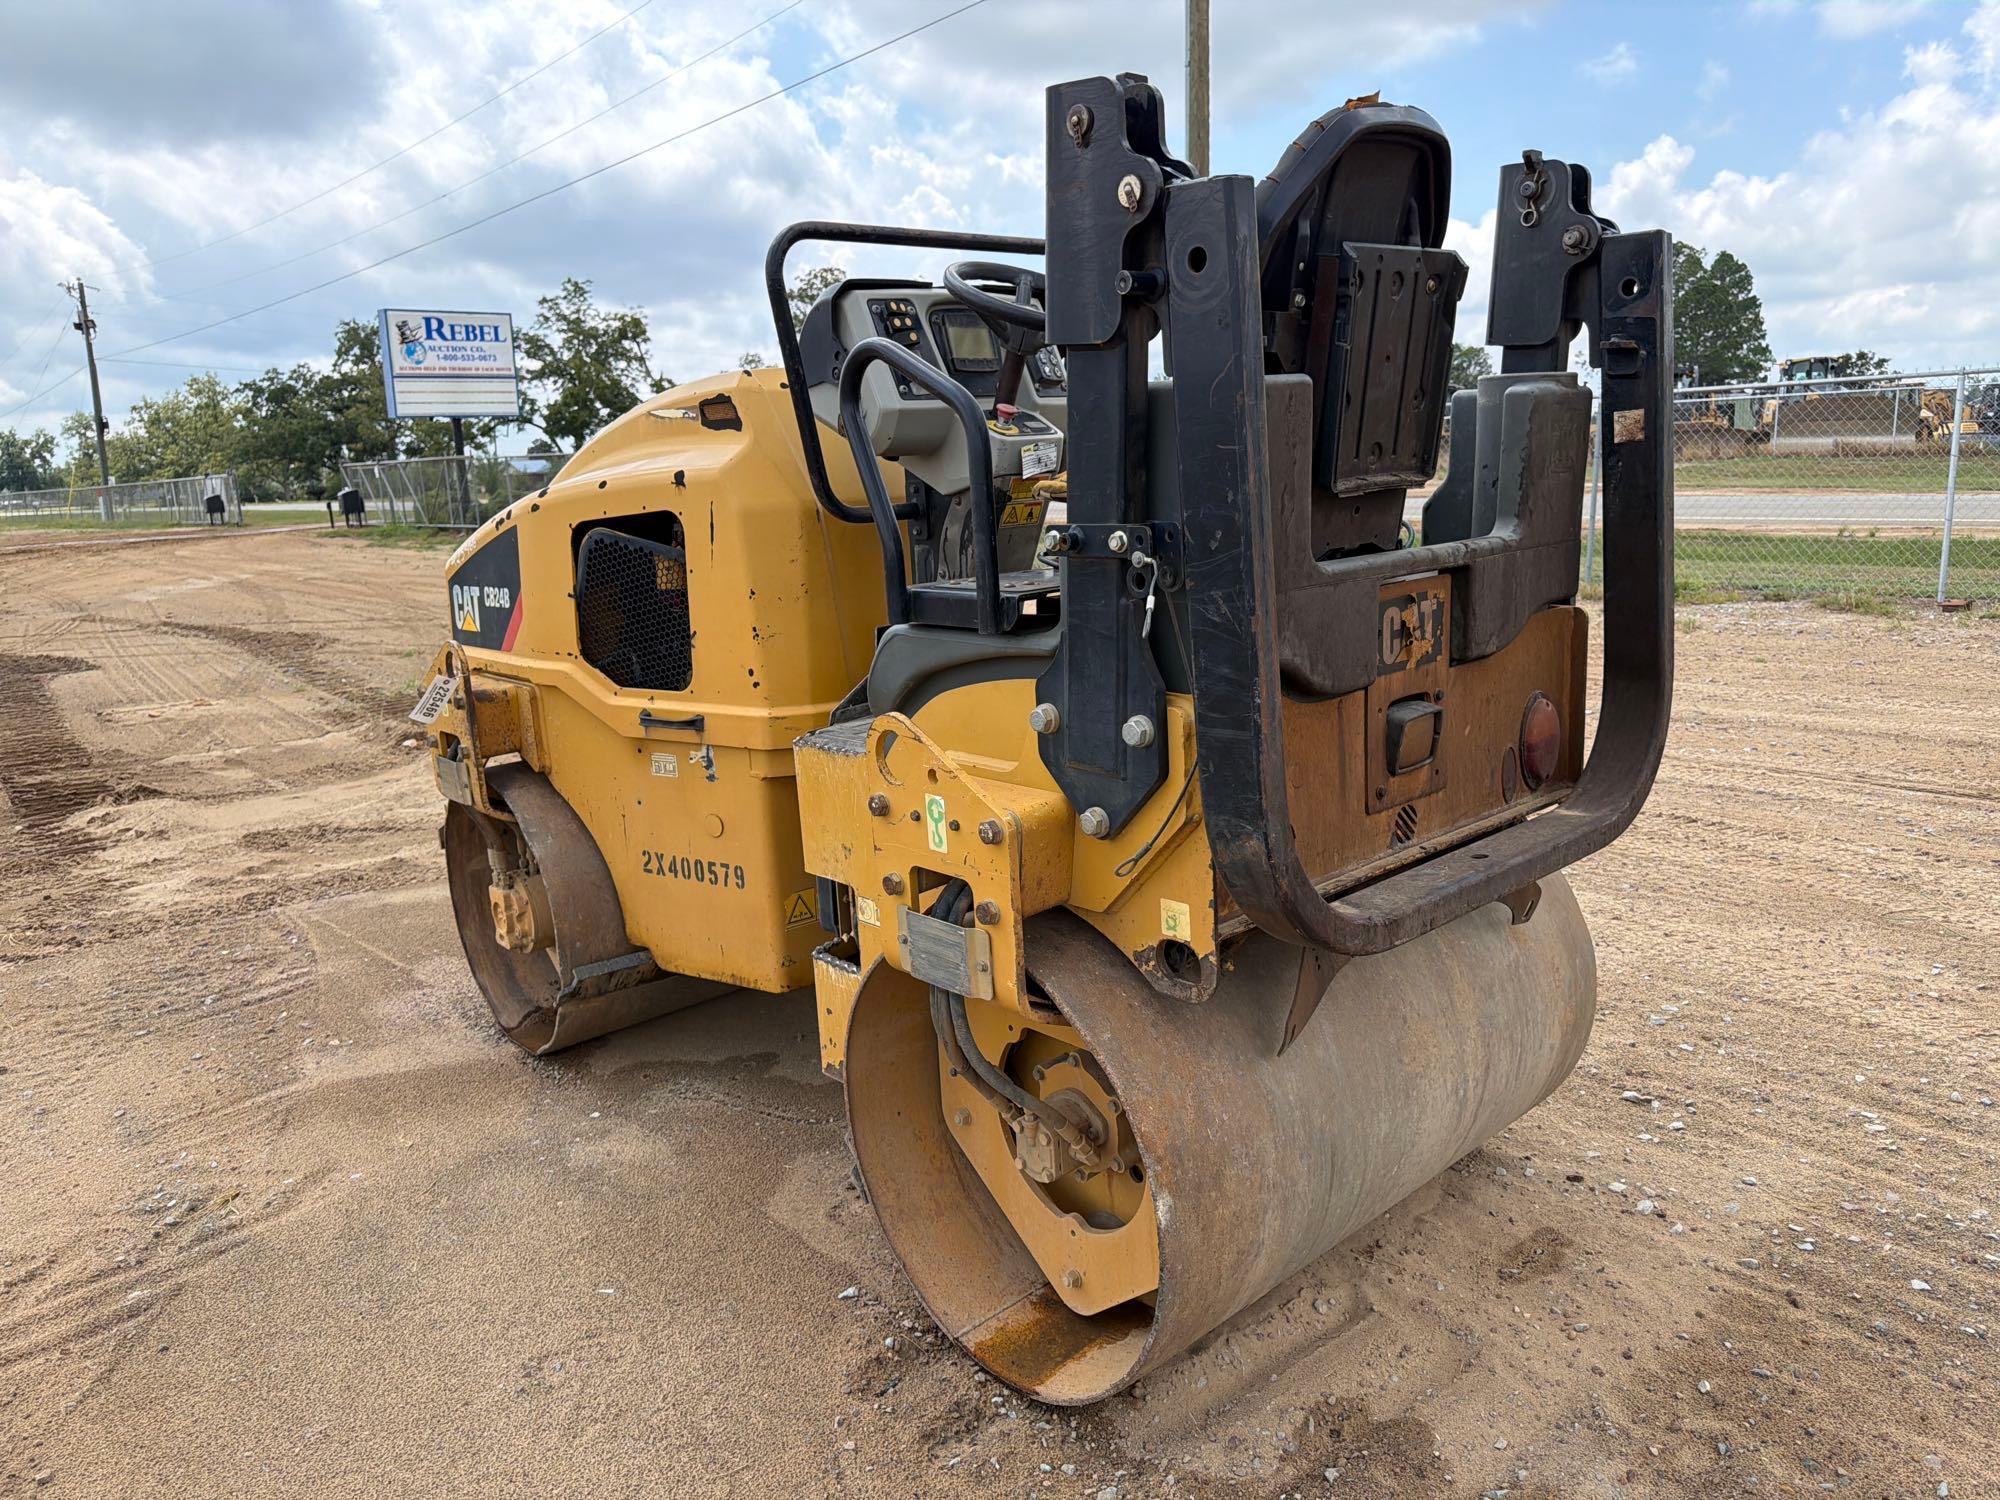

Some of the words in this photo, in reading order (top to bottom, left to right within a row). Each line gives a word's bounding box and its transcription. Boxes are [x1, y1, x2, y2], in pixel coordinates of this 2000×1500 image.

[423, 316, 507, 343] REBEL
[427, 345, 467, 353] AUCTION
[453, 584, 481, 632] CAT
[483, 586, 510, 608] CB24B
[423, 686, 450, 718] 225466
[641, 849, 746, 890] 2X400579
